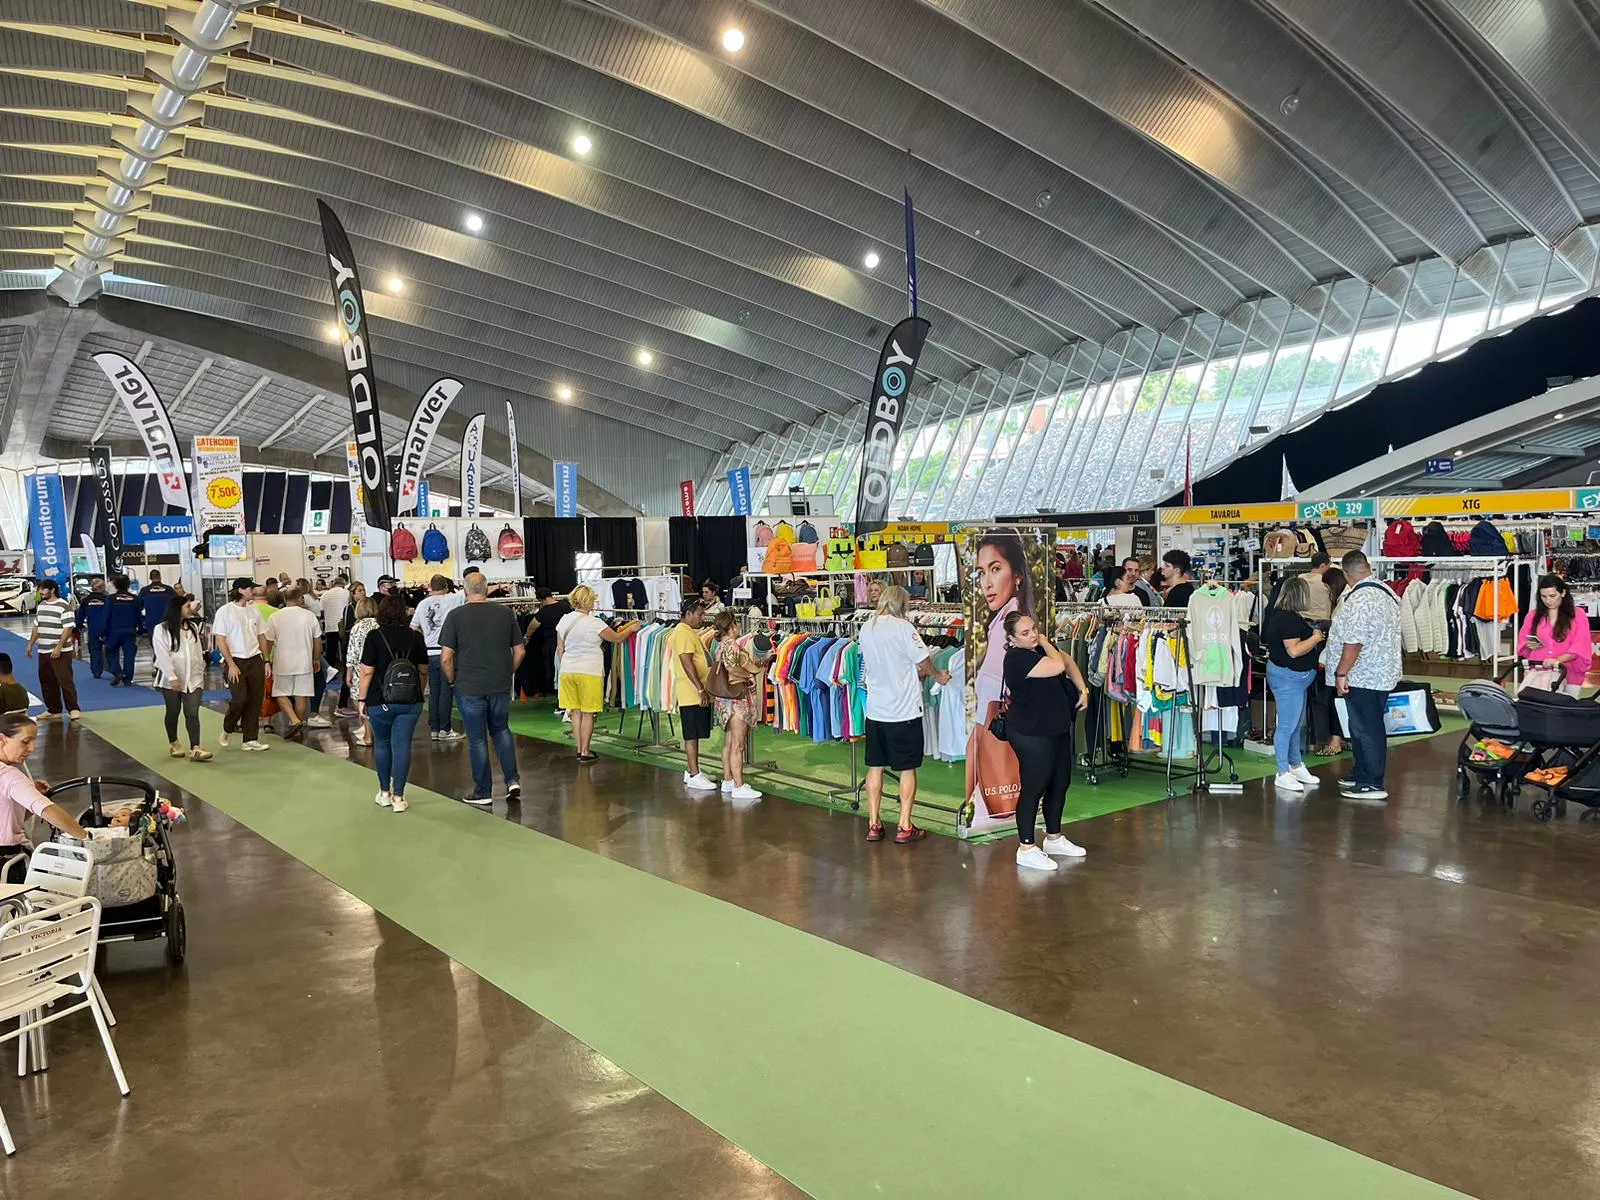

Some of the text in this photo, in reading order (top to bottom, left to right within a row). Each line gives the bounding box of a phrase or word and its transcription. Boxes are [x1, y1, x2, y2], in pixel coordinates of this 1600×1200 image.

[329, 253, 381, 490] OLDBOY
[863, 339, 914, 504] OLDBOY
[405, 386, 448, 477] marver
[96, 457, 120, 551] COLOSSUS
[1345, 502, 1362, 514] 329
[1462, 499, 1480, 510] XTG
[36, 476, 57, 565] dormitorum
[1128, 514, 1139, 522] 331
[1210, 510, 1241, 519] TAVARUA
[154, 522, 192, 534] dormi
[999, 784, 1018, 794] POLO
[31, 927, 62, 940] VICTORIA
